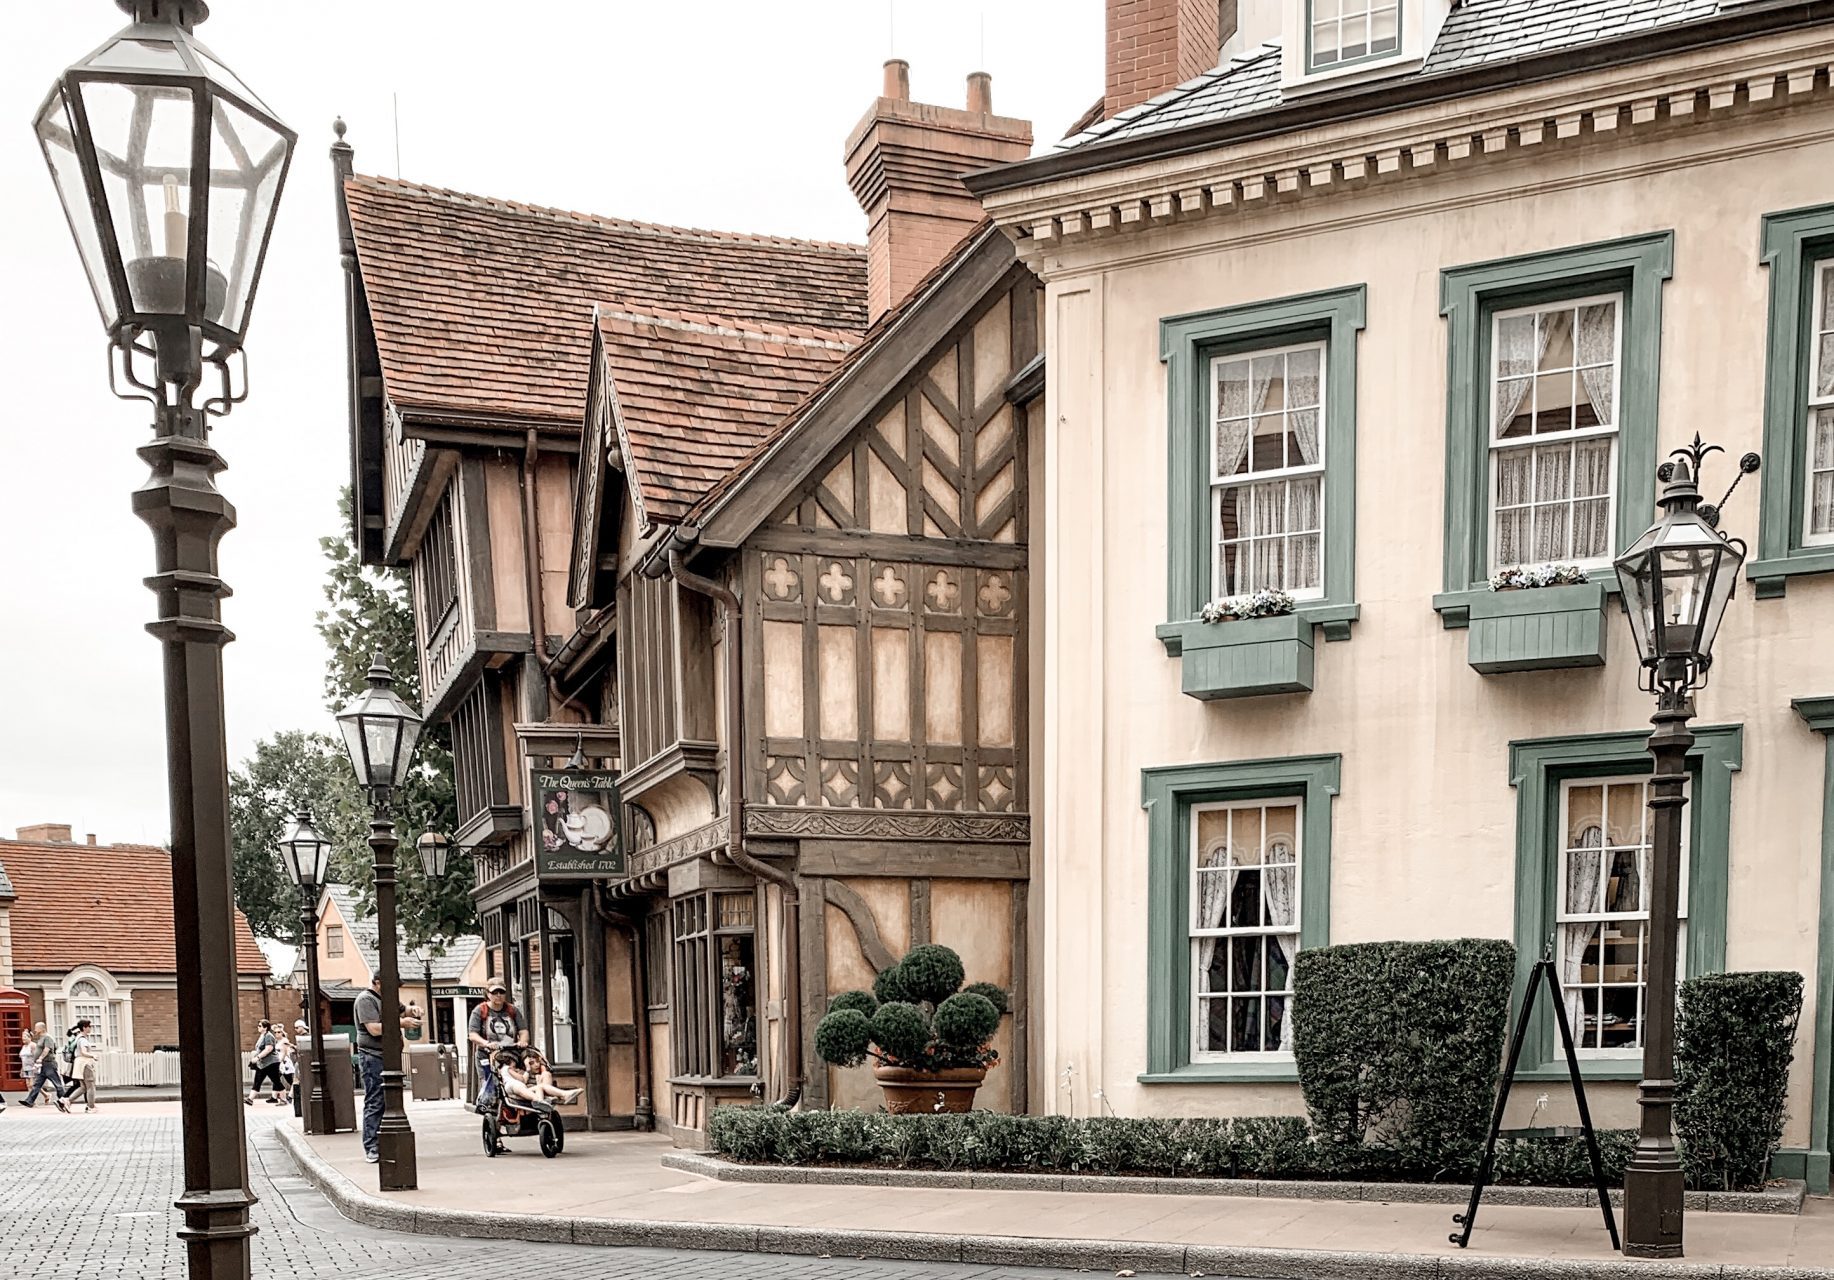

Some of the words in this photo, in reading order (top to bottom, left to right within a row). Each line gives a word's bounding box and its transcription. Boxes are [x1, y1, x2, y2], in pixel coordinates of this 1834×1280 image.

[540, 775, 558, 788] The
[560, 775, 589, 790] Queen's
[591, 776, 614, 788] Table
[547, 859, 596, 870] Established
[598, 860, 616, 870] 1702
[468, 987, 484, 995] FAM
